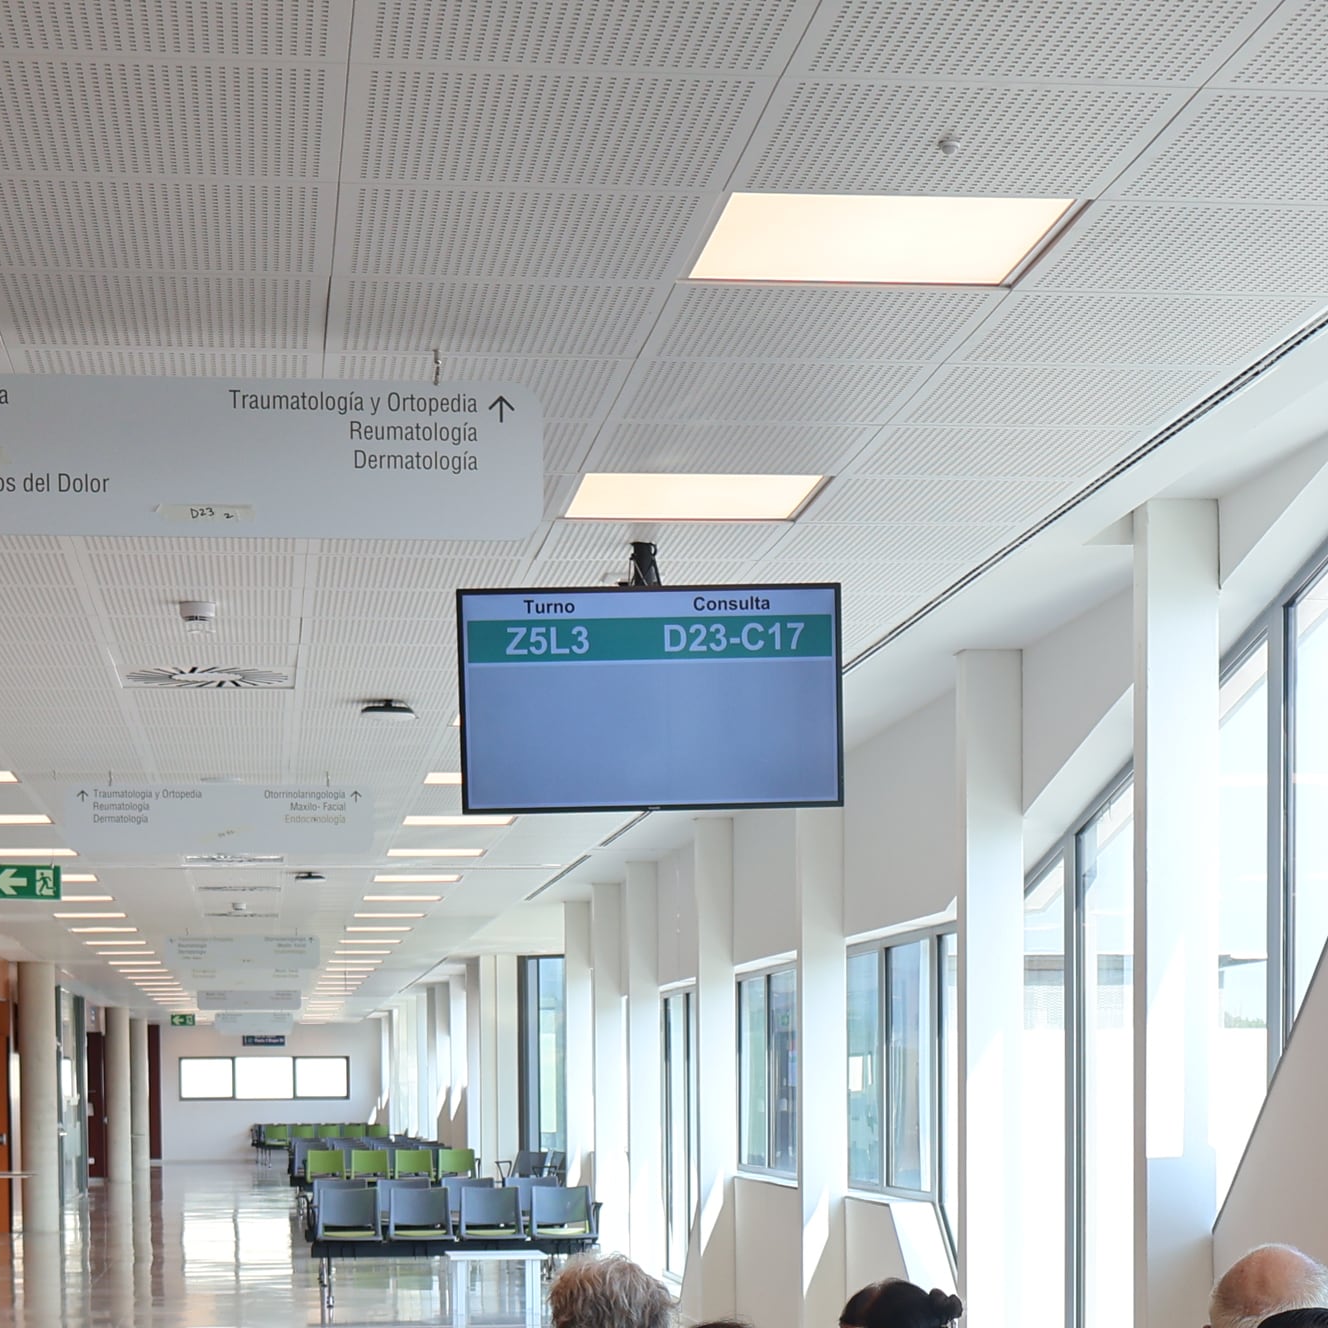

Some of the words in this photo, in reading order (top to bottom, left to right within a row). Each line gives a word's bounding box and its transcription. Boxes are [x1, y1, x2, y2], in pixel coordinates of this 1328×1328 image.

[229, 389, 364, 414] Traumatología
[370, 396, 380, 415] y
[387, 391, 478, 416] Ortopedia
[350, 420, 478, 445] Reumatología
[354, 449, 478, 475] Dermatología
[23, 472, 50, 493] del
[57, 472, 110, 494] Dolor
[523, 599, 576, 614] Turno
[693, 595, 771, 612] Consulta
[505, 624, 590, 656] Z5L3
[663, 620, 805, 653] D23-C17
[162, 789, 203, 800] Ortopedia
[93, 801, 150, 812] Reumatología
[323, 802, 346, 811] Facial
[93, 814, 149, 825] Dermatología
